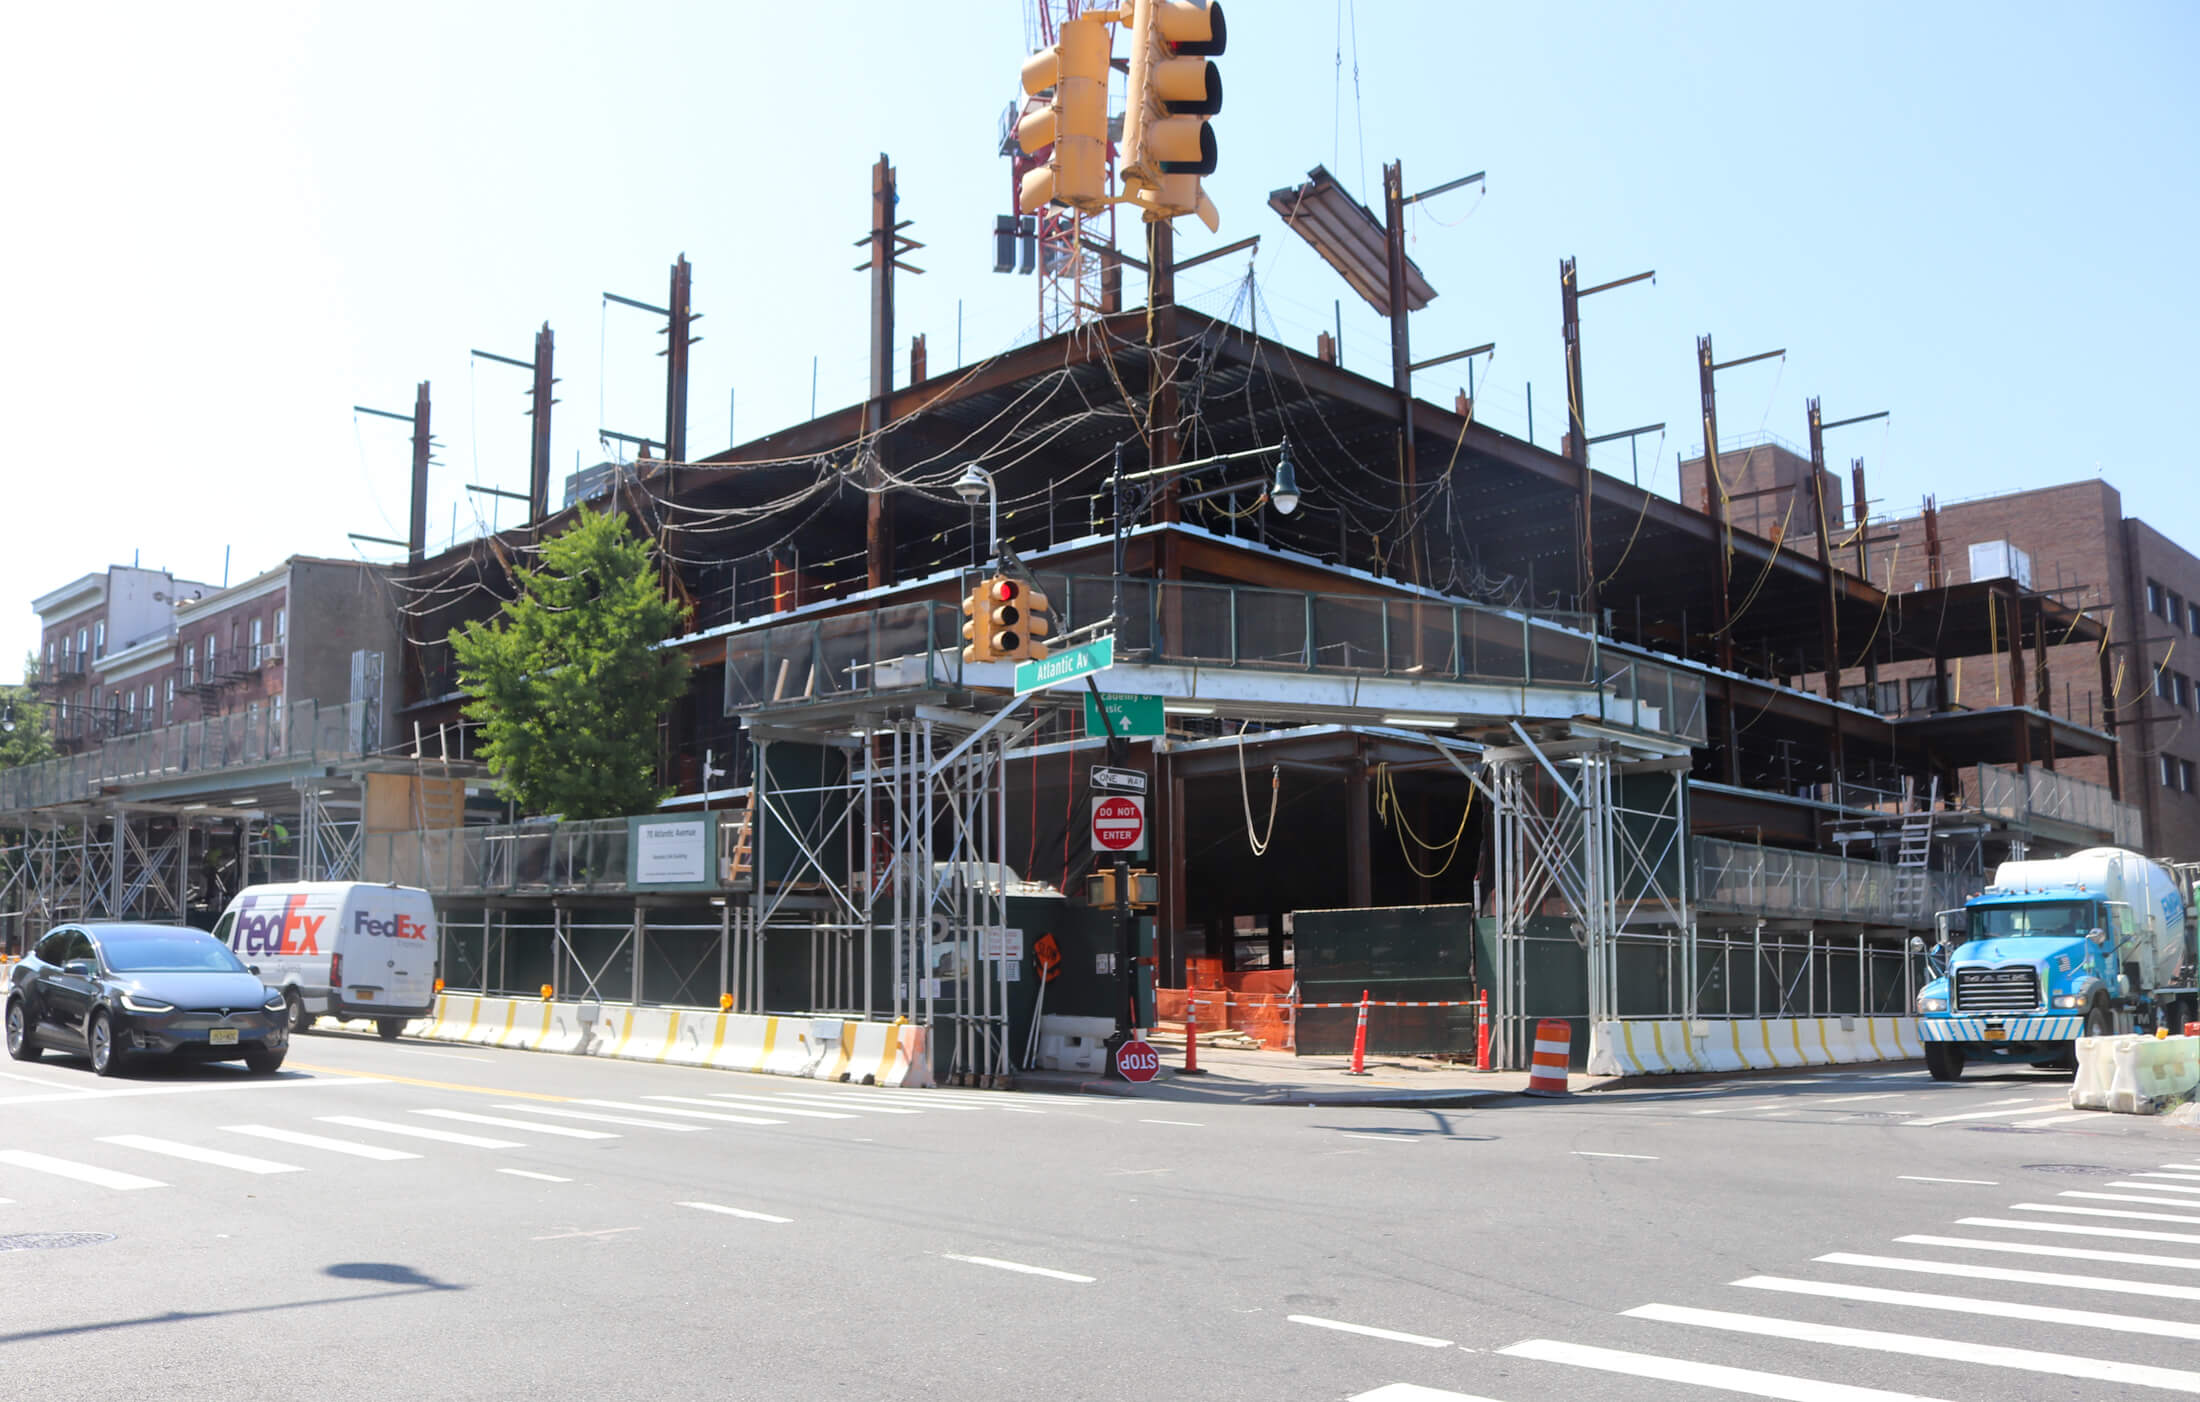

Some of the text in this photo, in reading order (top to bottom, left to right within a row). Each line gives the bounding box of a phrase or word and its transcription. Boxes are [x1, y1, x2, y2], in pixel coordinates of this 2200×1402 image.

[1037, 652, 1089, 681] Atlantic Av
[1099, 773, 1145, 787] ONE WAY
[1100, 807, 1135, 817] DO NOT
[1103, 831, 1132, 841] ENTER
[232, 893, 327, 957] FedEx
[354, 911, 427, 941] FedEx
[1963, 974, 2030, 982] MACK
[1120, 1054, 1157, 1070] STOP
